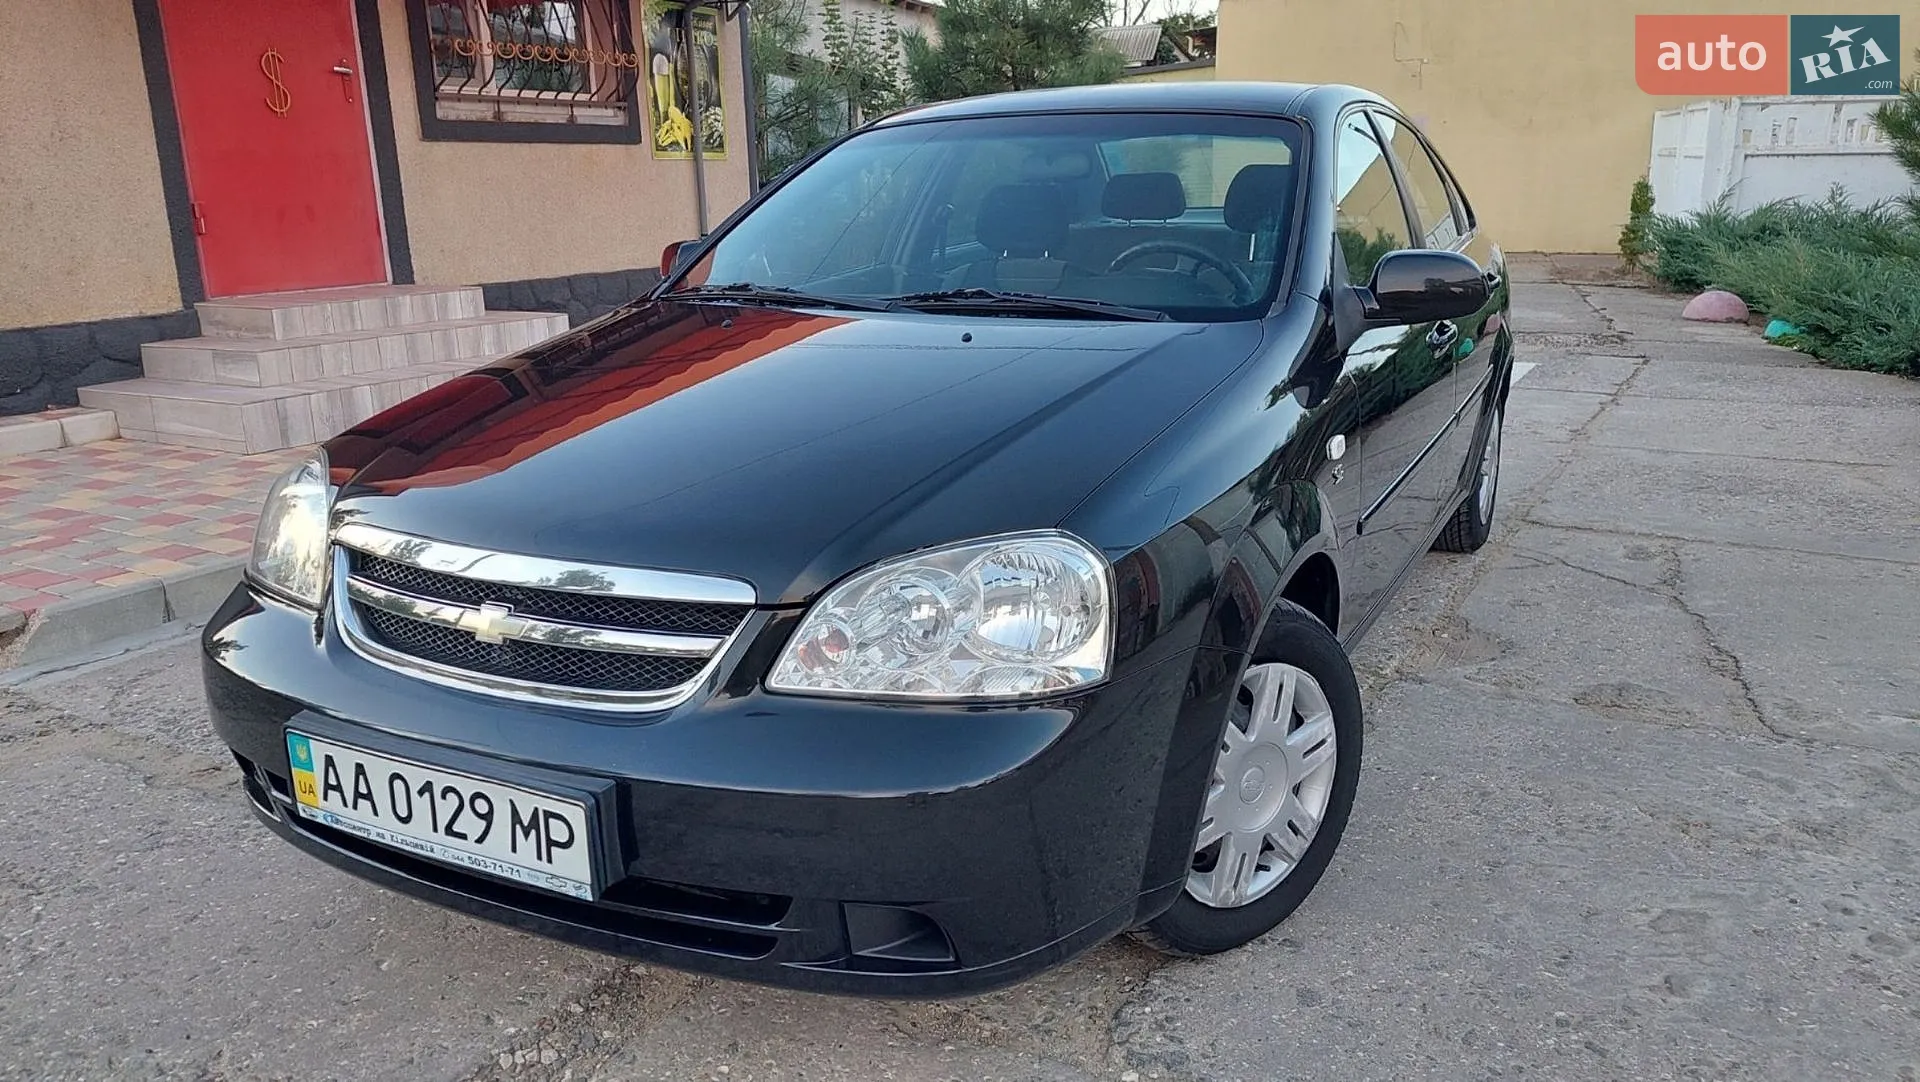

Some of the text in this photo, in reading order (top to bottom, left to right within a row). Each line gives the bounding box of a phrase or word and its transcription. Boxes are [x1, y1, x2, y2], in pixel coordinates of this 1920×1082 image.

[298, 781, 317, 797] UA
[323, 754, 575, 865] AA 0129 MP
[467, 855, 522, 878] 503-71-71
